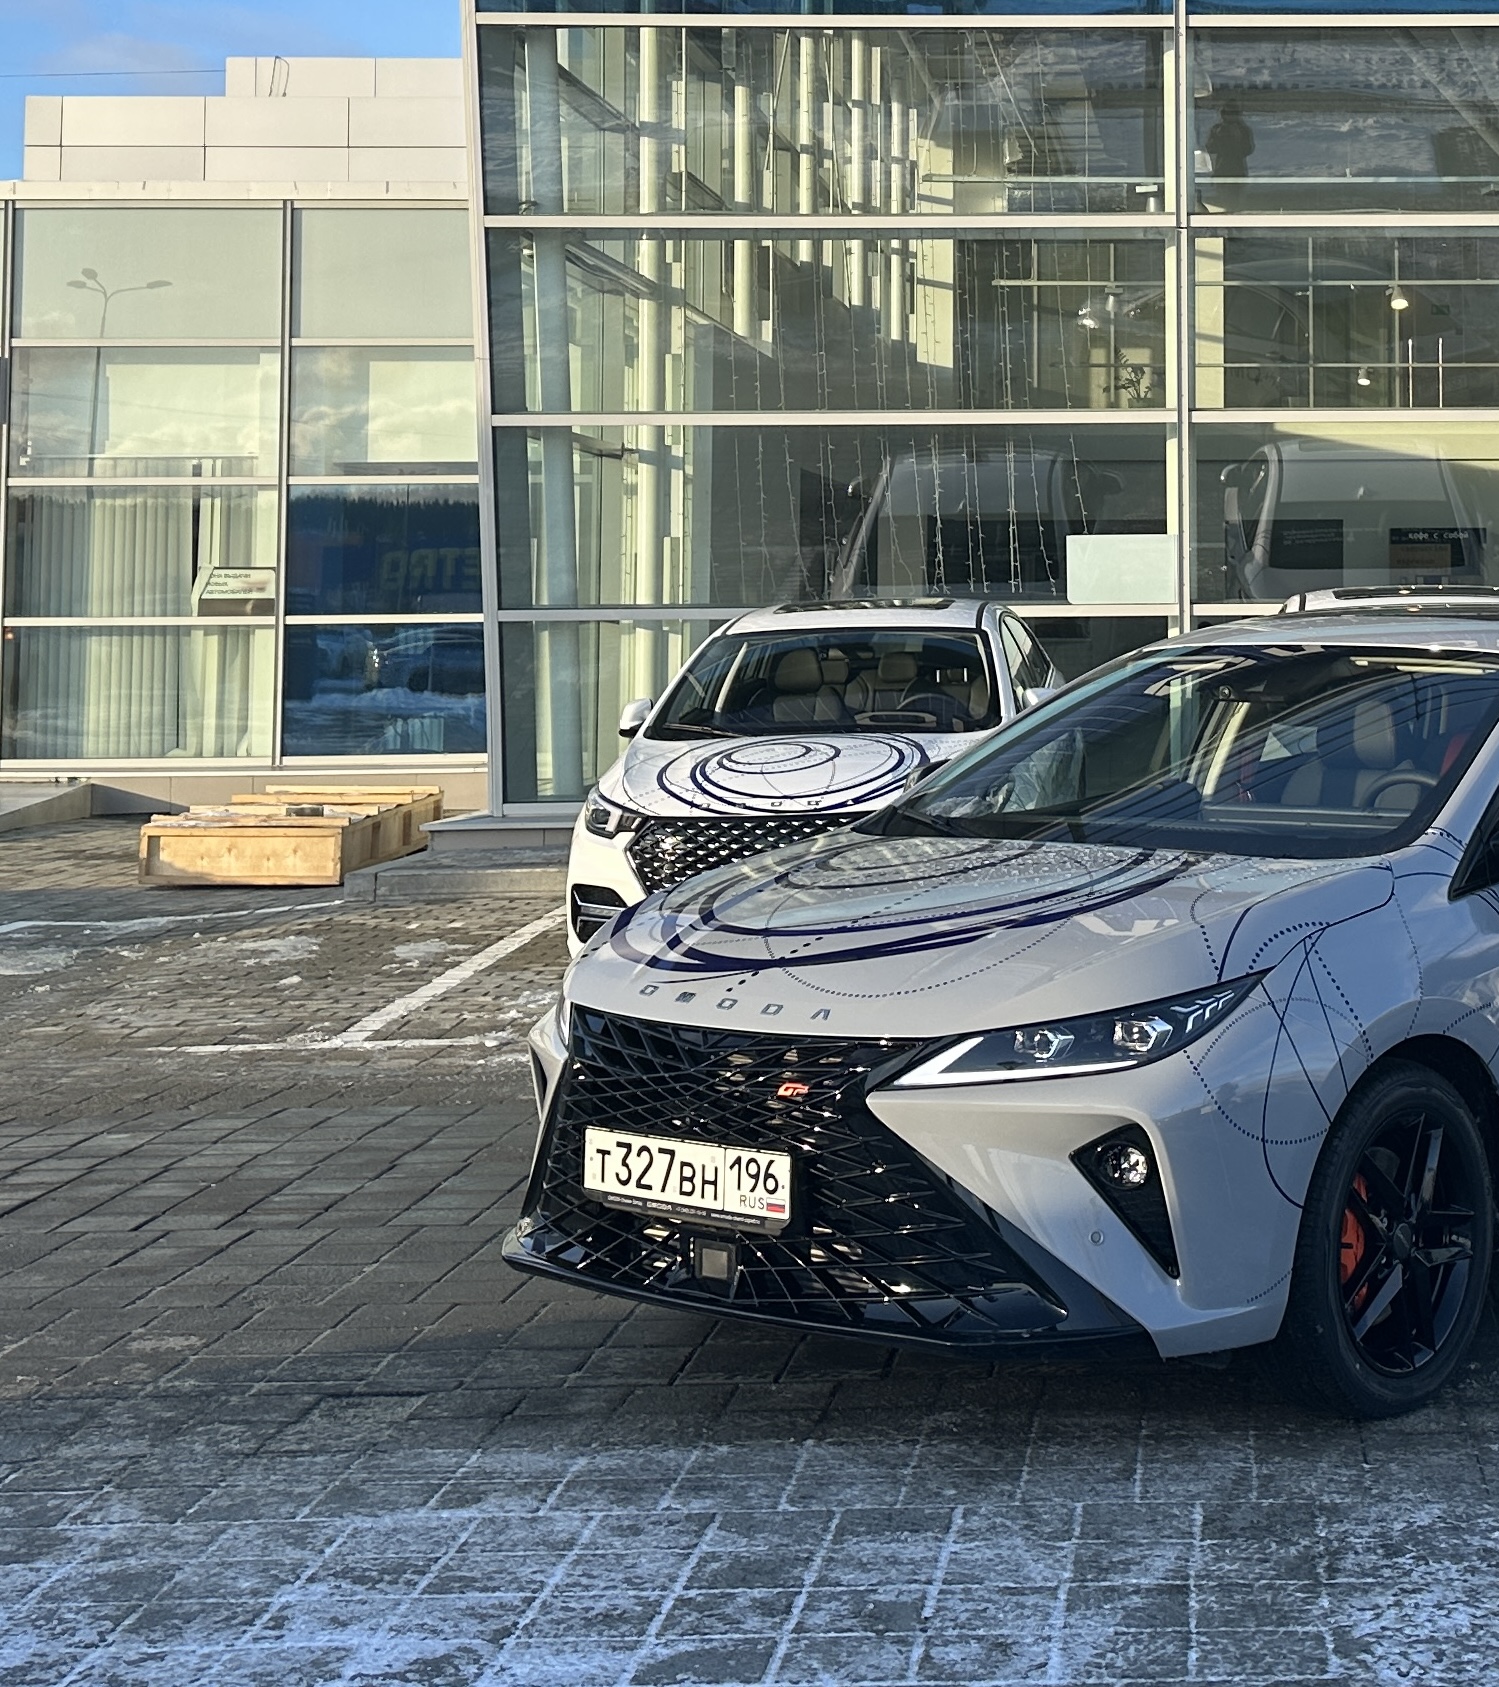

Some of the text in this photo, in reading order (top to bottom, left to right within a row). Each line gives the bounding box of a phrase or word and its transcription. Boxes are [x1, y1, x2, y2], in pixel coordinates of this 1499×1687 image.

[639, 984, 832, 1021] OMODA
[728, 1154, 780, 1196] 196
[739, 1194, 765, 1211] RUS
